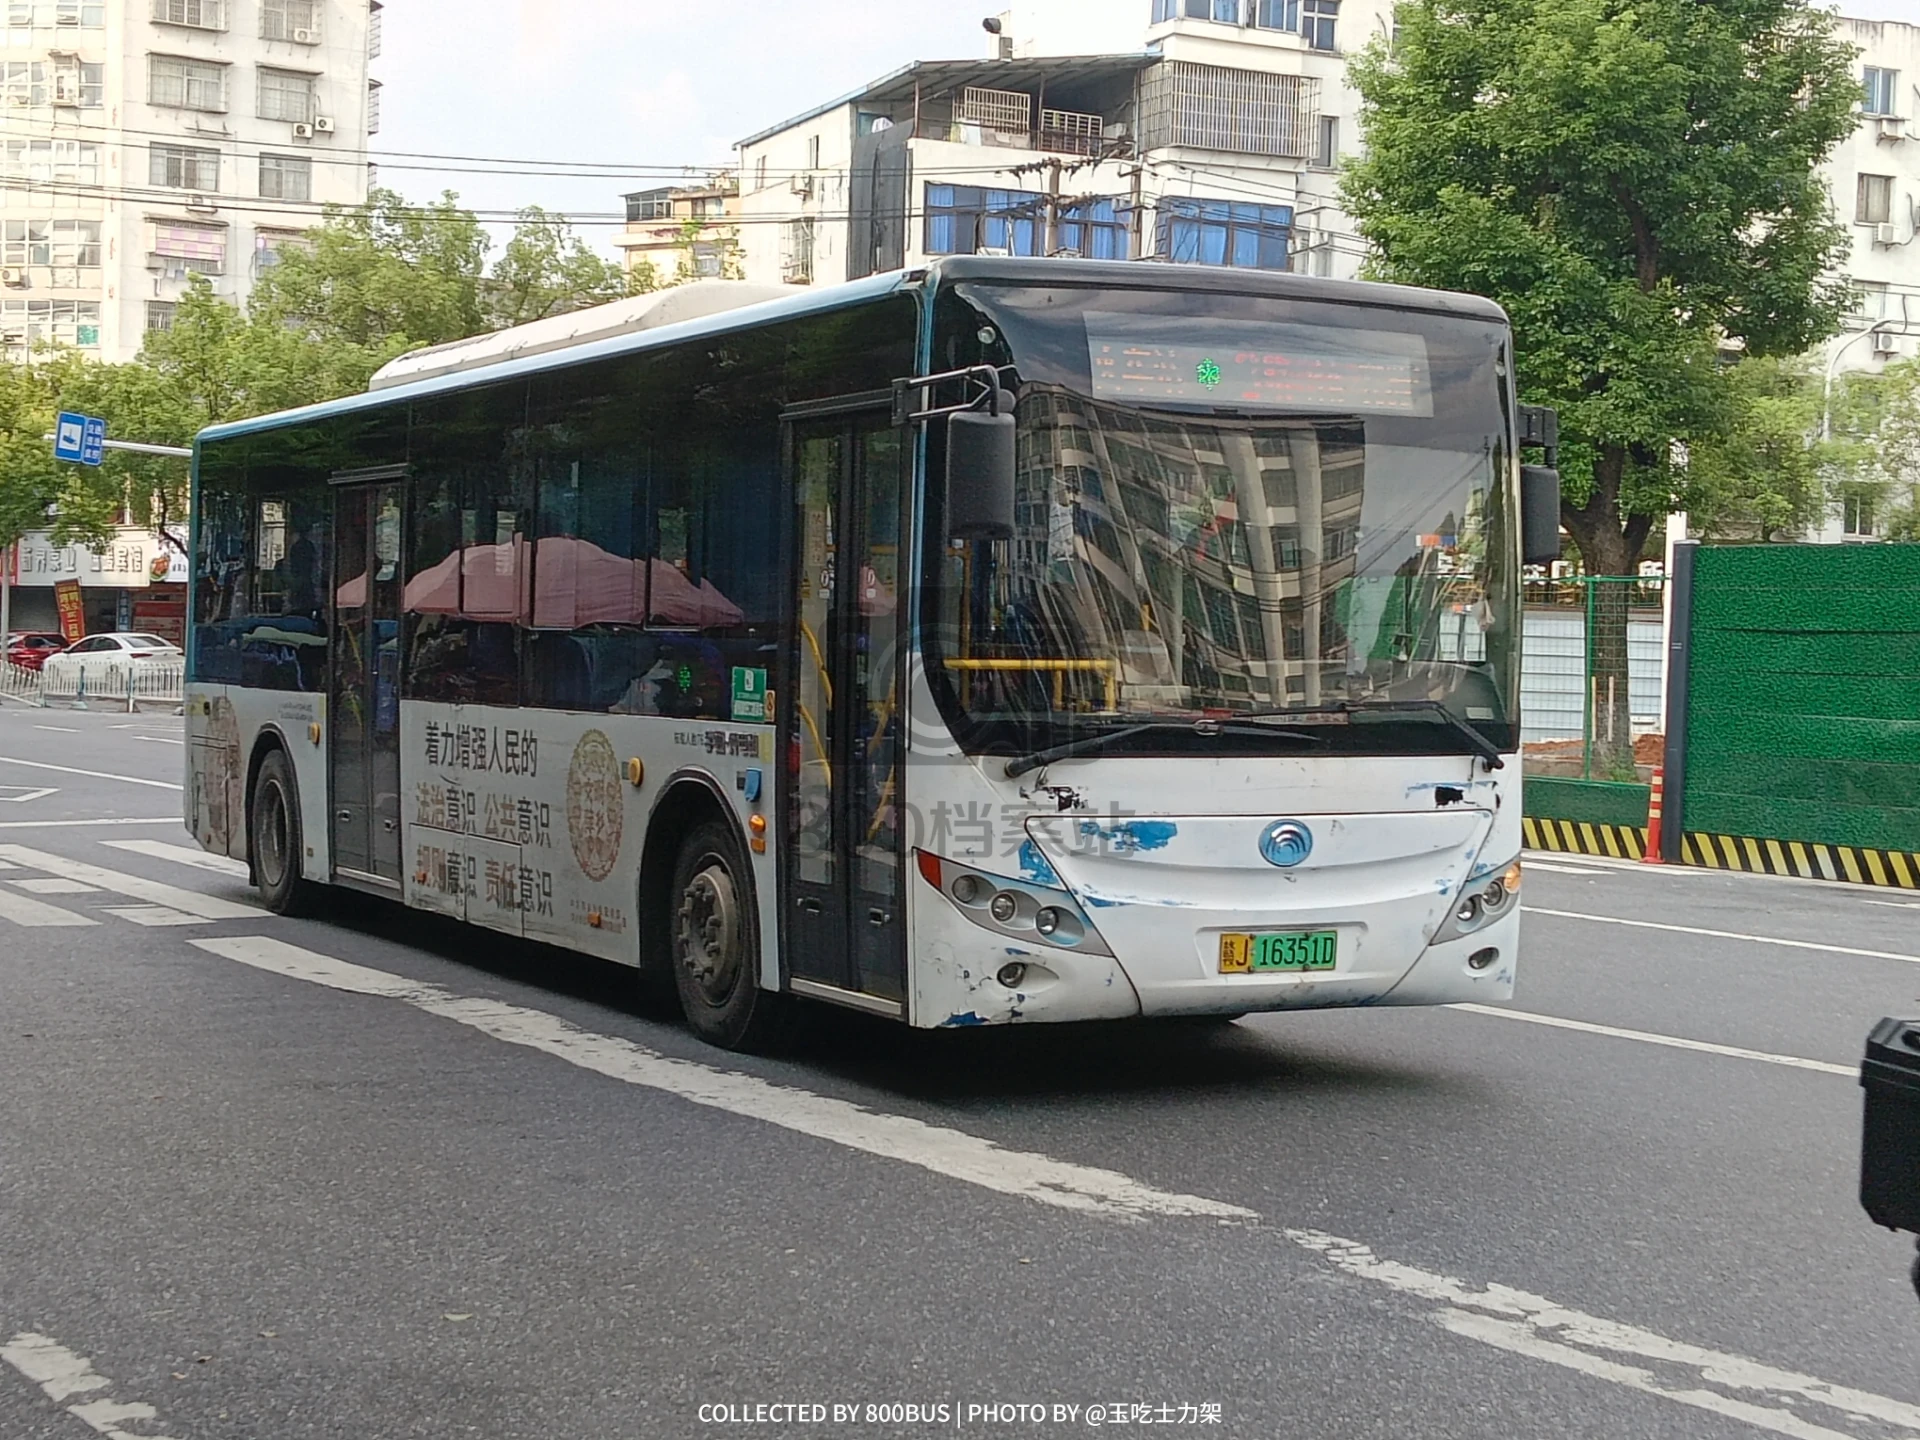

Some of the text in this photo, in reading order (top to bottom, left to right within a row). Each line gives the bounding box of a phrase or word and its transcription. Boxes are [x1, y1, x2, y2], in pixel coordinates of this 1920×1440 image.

[425, 720, 538, 778] 着力增强人民的
[415, 781, 552, 849] 法治意识 公共意识
[485, 858, 554, 918] 责任意识
